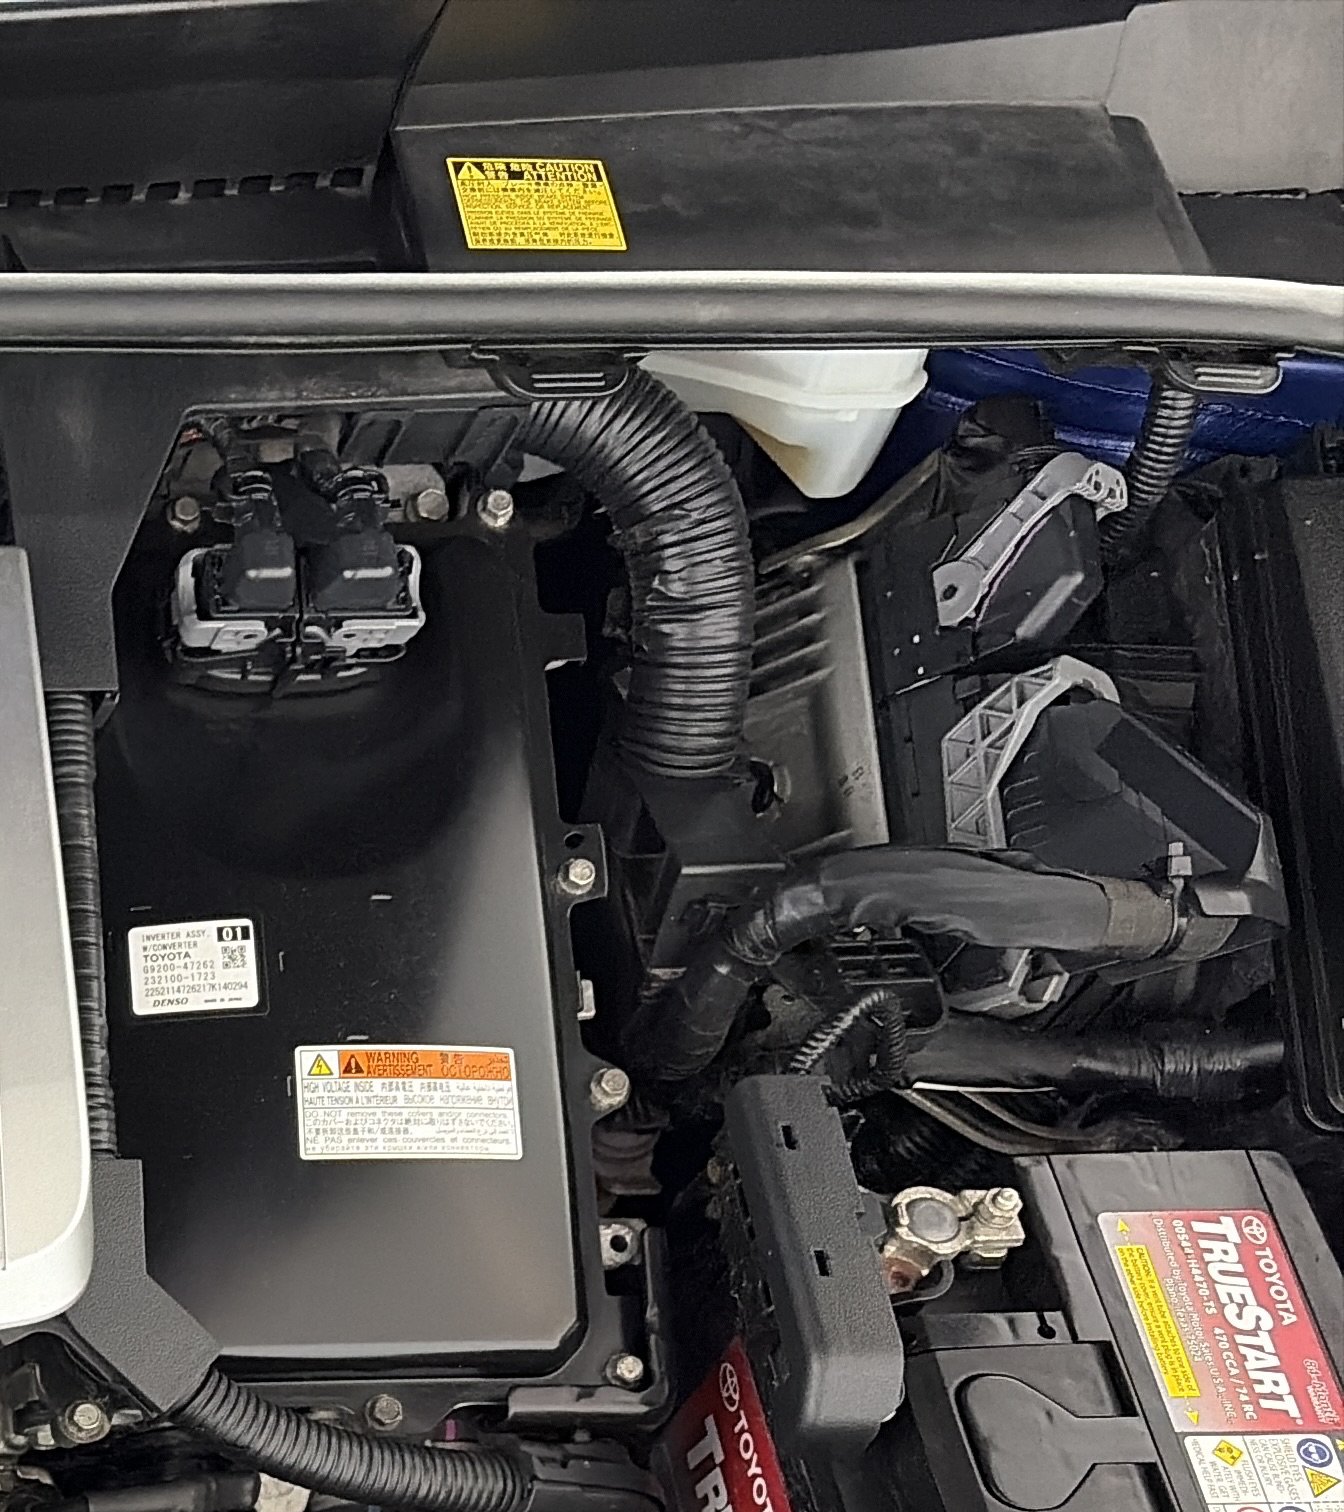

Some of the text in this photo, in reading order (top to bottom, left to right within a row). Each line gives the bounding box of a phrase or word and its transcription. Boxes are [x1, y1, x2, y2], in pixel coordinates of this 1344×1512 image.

[534, 162, 595, 172] CAUTION
[522, 171, 598, 181] ATTENTION
[141, 931, 181, 942] INVERTER
[221, 925, 242, 941] 01
[141, 940, 198, 952] W/CONVERTER
[142, 950, 192, 963] TOYOTA
[142, 959, 215, 974] G9200-47262
[143, 970, 216, 985] 232100-1723
[151, 997, 189, 1007] DENSO
[365, 1051, 420, 1064] WARNING
[365, 1063, 433, 1077] AVERTISSEMENT
[303, 1081, 321, 1093] HIGH
[321, 1081, 350, 1093] VOLTAGE
[303, 1095, 326, 1106] HAUTE
[325, 1095, 353, 1105] TENSION
[304, 1109, 322, 1118] DO
[325, 1109, 342, 1117] NOT
[324, 1136, 343, 1144] PAS
[1152, 1217, 1179, 1267] Distributed
[1173, 1280, 1194, 1311] Toyota
[1198, 1341, 1215, 1365] Sales
[1253, 1246, 1297, 1326] TOYOTA
[1150, 1289, 1162, 1303] vent
[1155, 1304, 1167, 1319] tube
[1212, 1326, 1231, 1349] 470
[1184, 1333, 1202, 1362] 75024
[1160, 1345, 1173, 1359] plug
[1172, 1374, 1185, 1392] place
[1221, 1351, 1240, 1375] CCA
[1180, 1369, 1192, 1383] side
[1234, 1386, 1250, 1401] 74
[1241, 1403, 1257, 1420] RC
[1257, 1437, 1271, 1456] CAN
[1264, 1455, 1278, 1472] CAUSE
[1279, 1437, 1304, 1483] SHIELD EYES
[1201, 1468, 1213, 1483] HELP
[1267, 1437, 1300, 1500] EXPLOSIVE GASES
[1239, 1459, 1261, 1497] FLUSH EYES
[1217, 1484, 1230, 1498] GET
[1228, 1486, 1241, 1502] WITH
